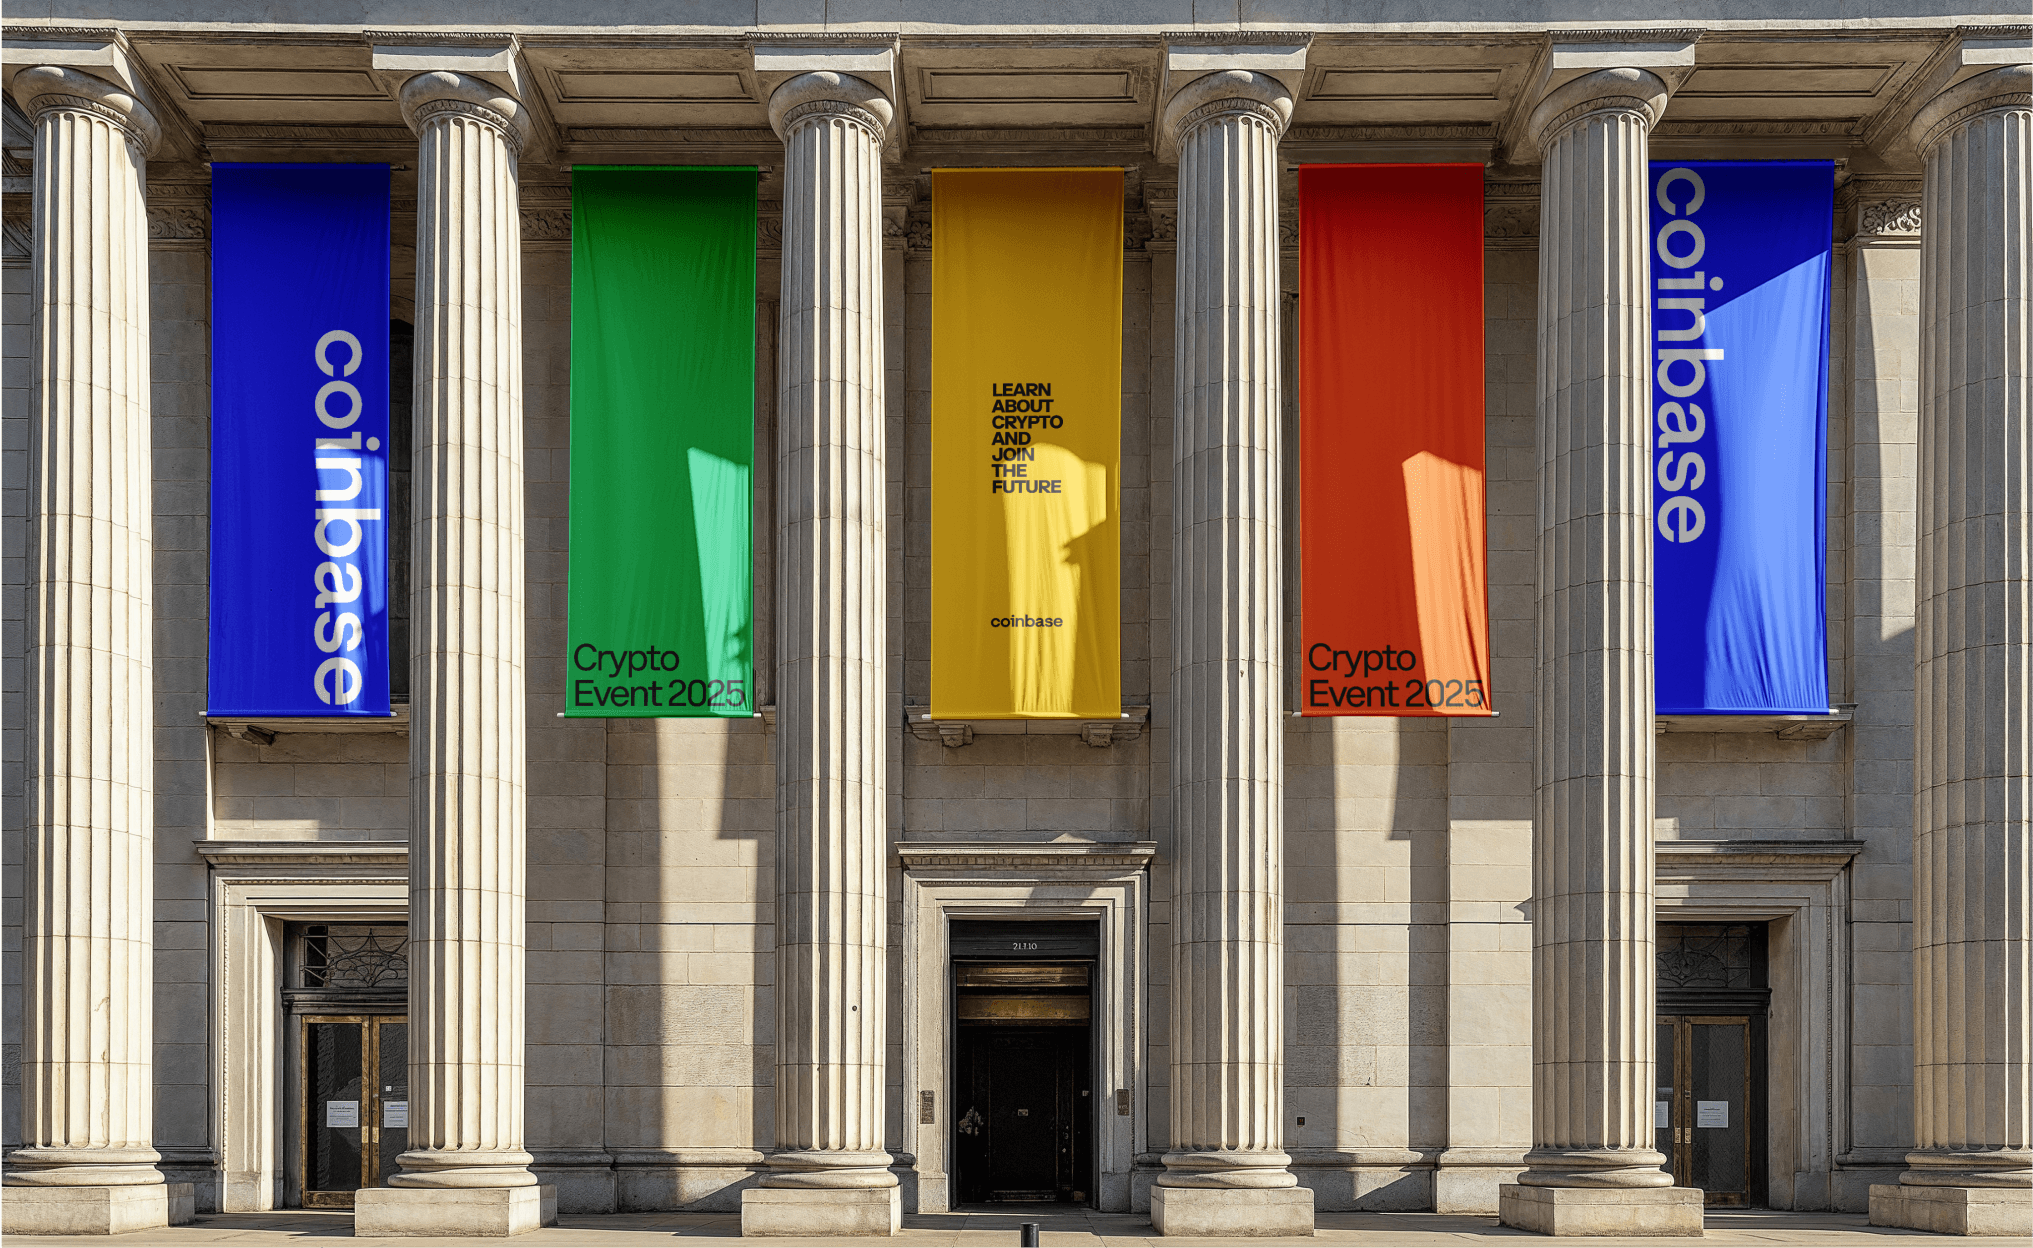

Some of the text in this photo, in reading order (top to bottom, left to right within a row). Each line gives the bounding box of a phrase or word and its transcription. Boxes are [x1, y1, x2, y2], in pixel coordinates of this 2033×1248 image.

[1656, 167, 1724, 543] coinbase
[992, 383, 1051, 397] LEARN
[992, 399, 1054, 413] ABOUT
[992, 415, 1064, 429] CRYPTO
[992, 432, 1031, 446] AND
[992, 448, 1035, 462] JOIN
[992, 464, 1027, 478] THE
[992, 480, 1062, 494] FUTURE
[314, 329, 381, 705] coinbase
[990, 615, 1063, 628] coinbase
[574, 643, 680, 678] Crypto
[1309, 643, 1416, 678] Crypto
[575, 679, 745, 707] Event 2025
[1310, 679, 1484, 707] Event 2025
